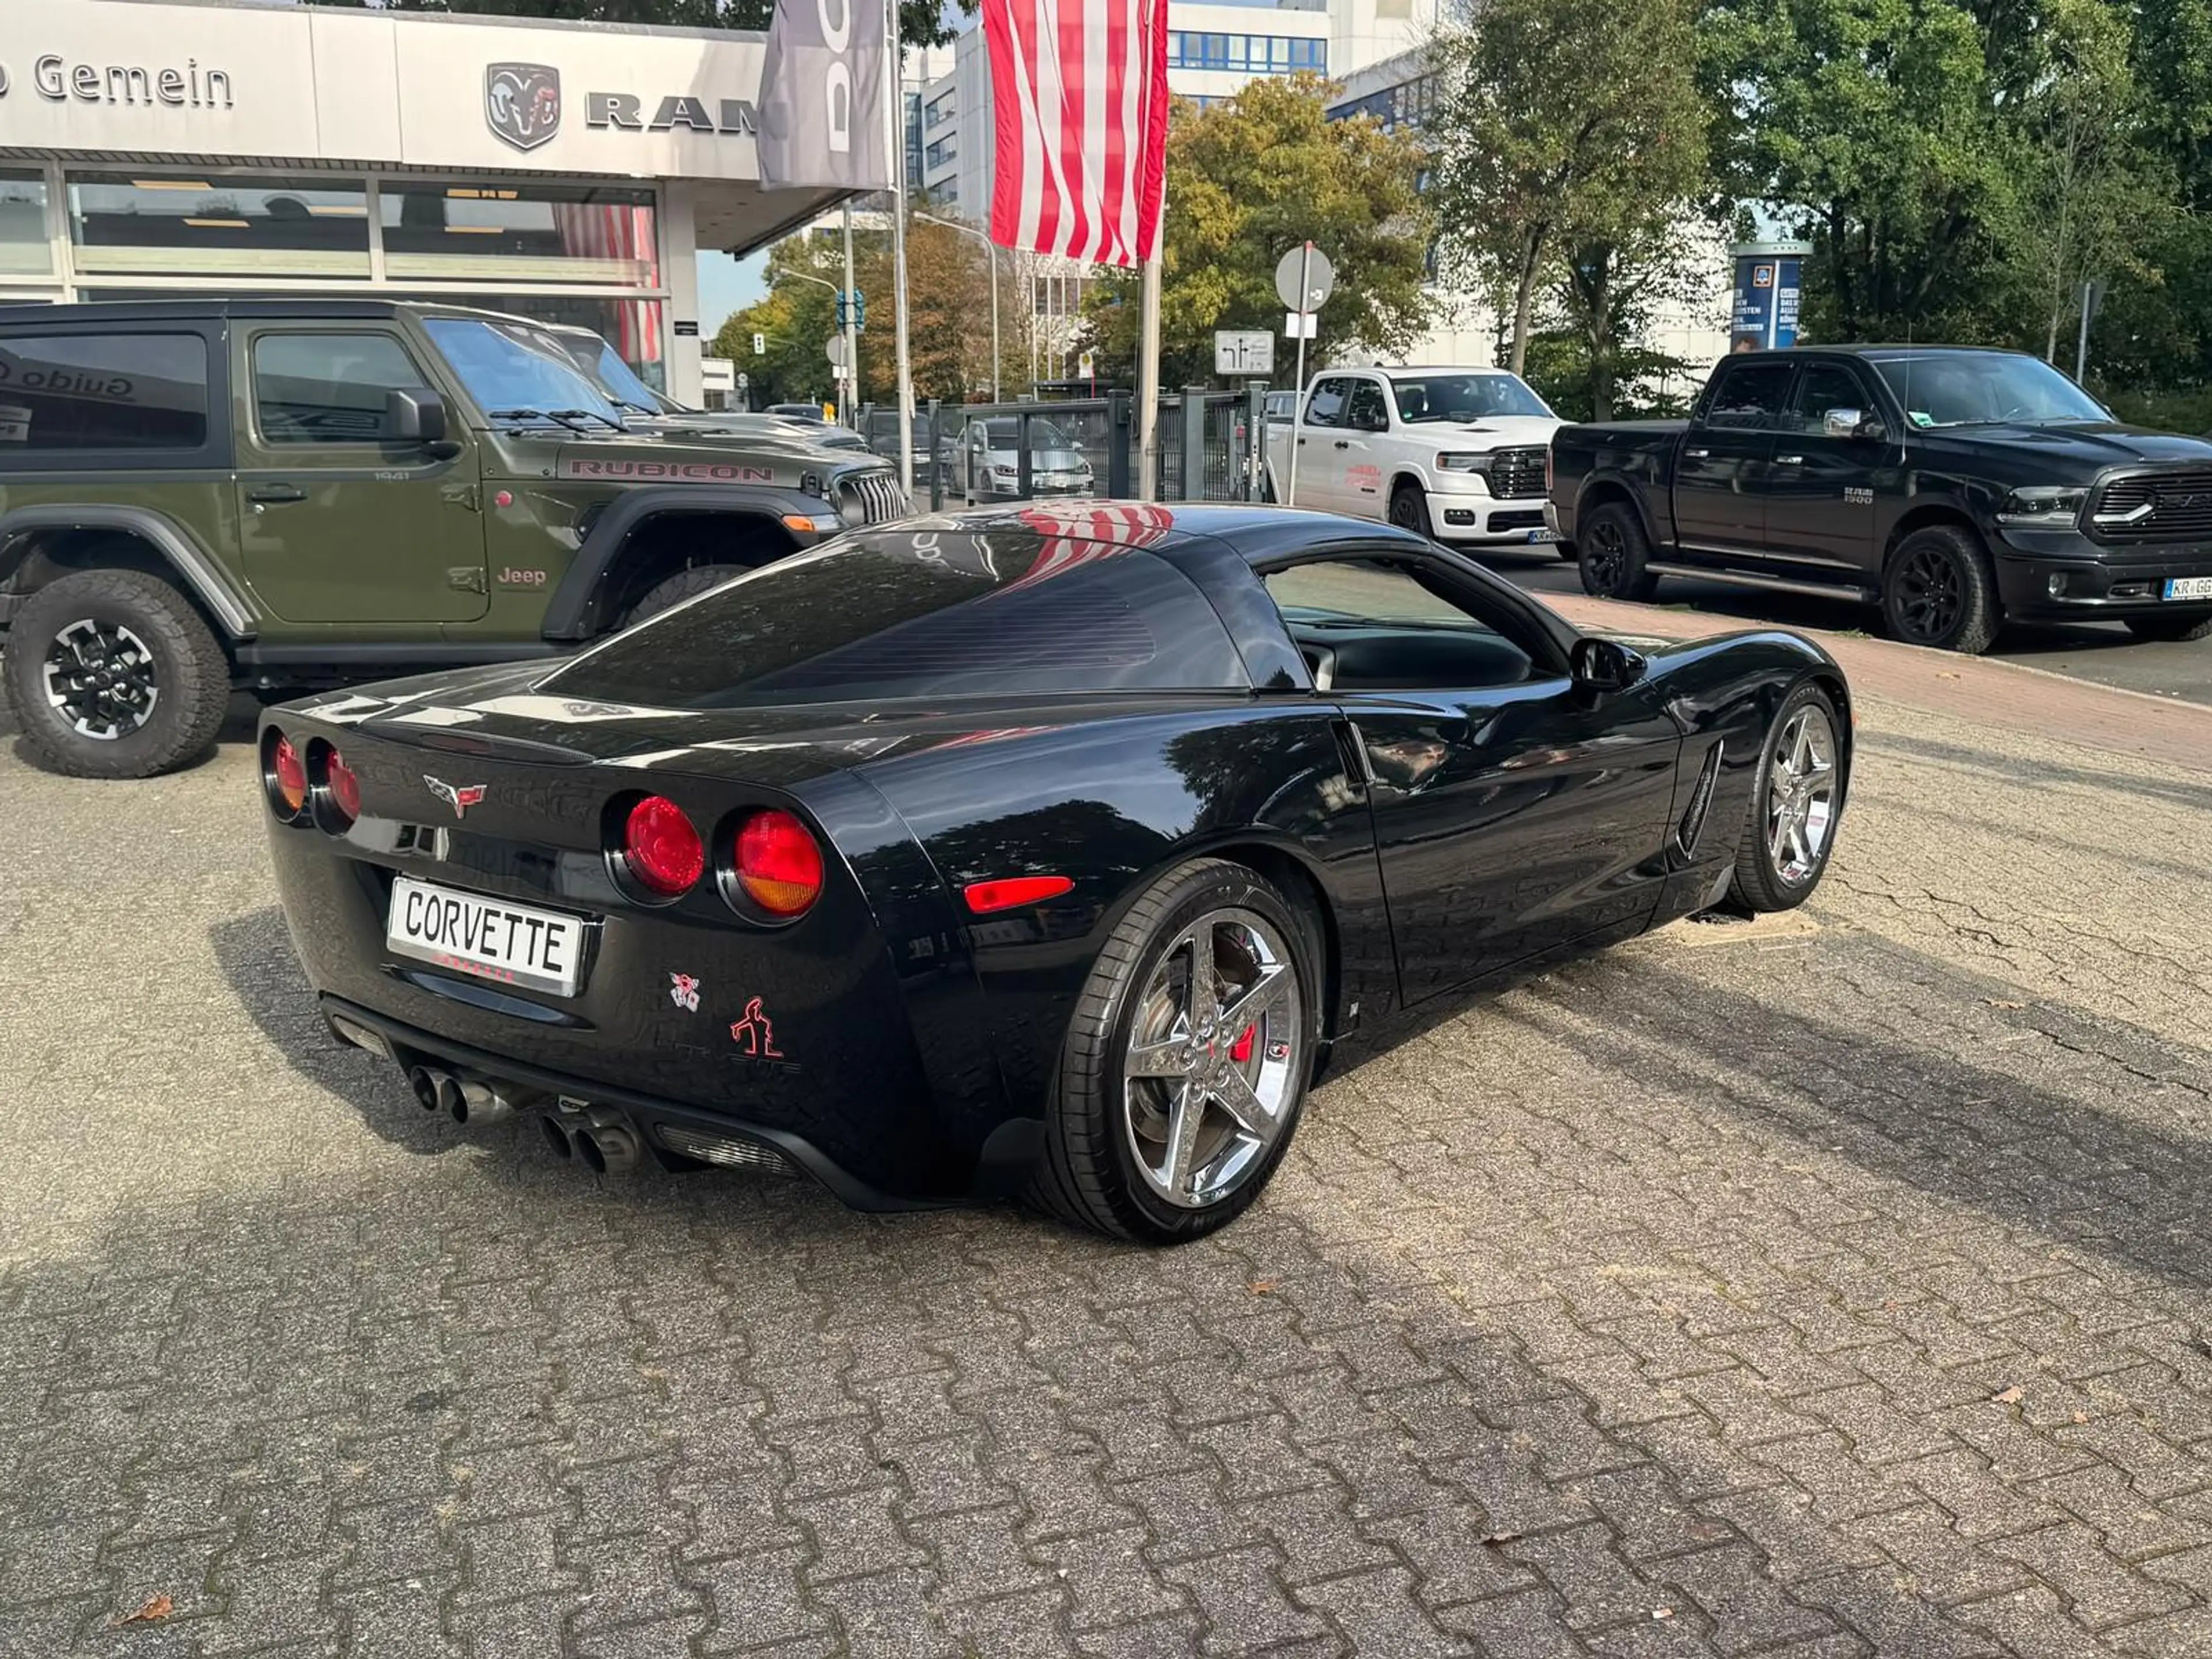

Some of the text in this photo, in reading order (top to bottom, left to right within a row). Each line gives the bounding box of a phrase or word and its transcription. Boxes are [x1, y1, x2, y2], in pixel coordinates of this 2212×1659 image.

[35, 54, 233, 108] Gemein
[571, 460, 774, 482] RUBICON
[497, 567, 546, 586] Jeep
[2174, 580, 2190, 594] KR
[407, 892, 566, 973] CORVETTE
